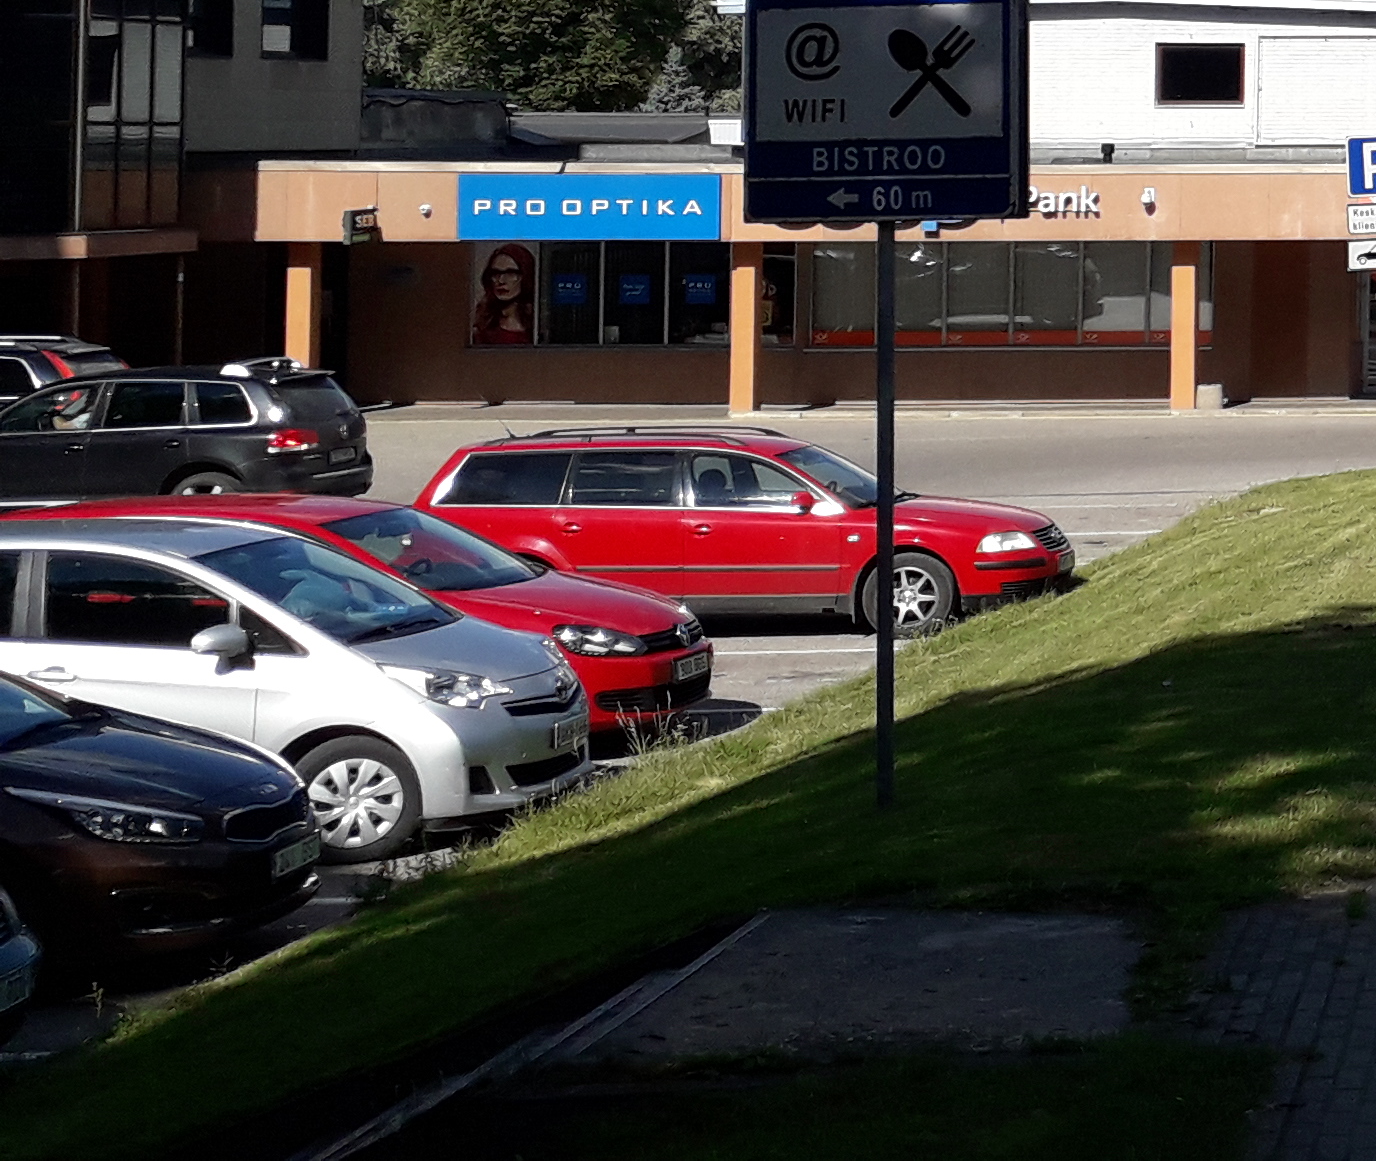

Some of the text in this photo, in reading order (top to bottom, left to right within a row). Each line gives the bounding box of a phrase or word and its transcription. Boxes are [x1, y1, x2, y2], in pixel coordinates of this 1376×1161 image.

[784, 98, 845, 123] WIFI
[812, 145, 945, 172] BISTROO
[473, 199, 702, 215] PRO OPTIKA
[872, 185, 932, 211] 60 m
